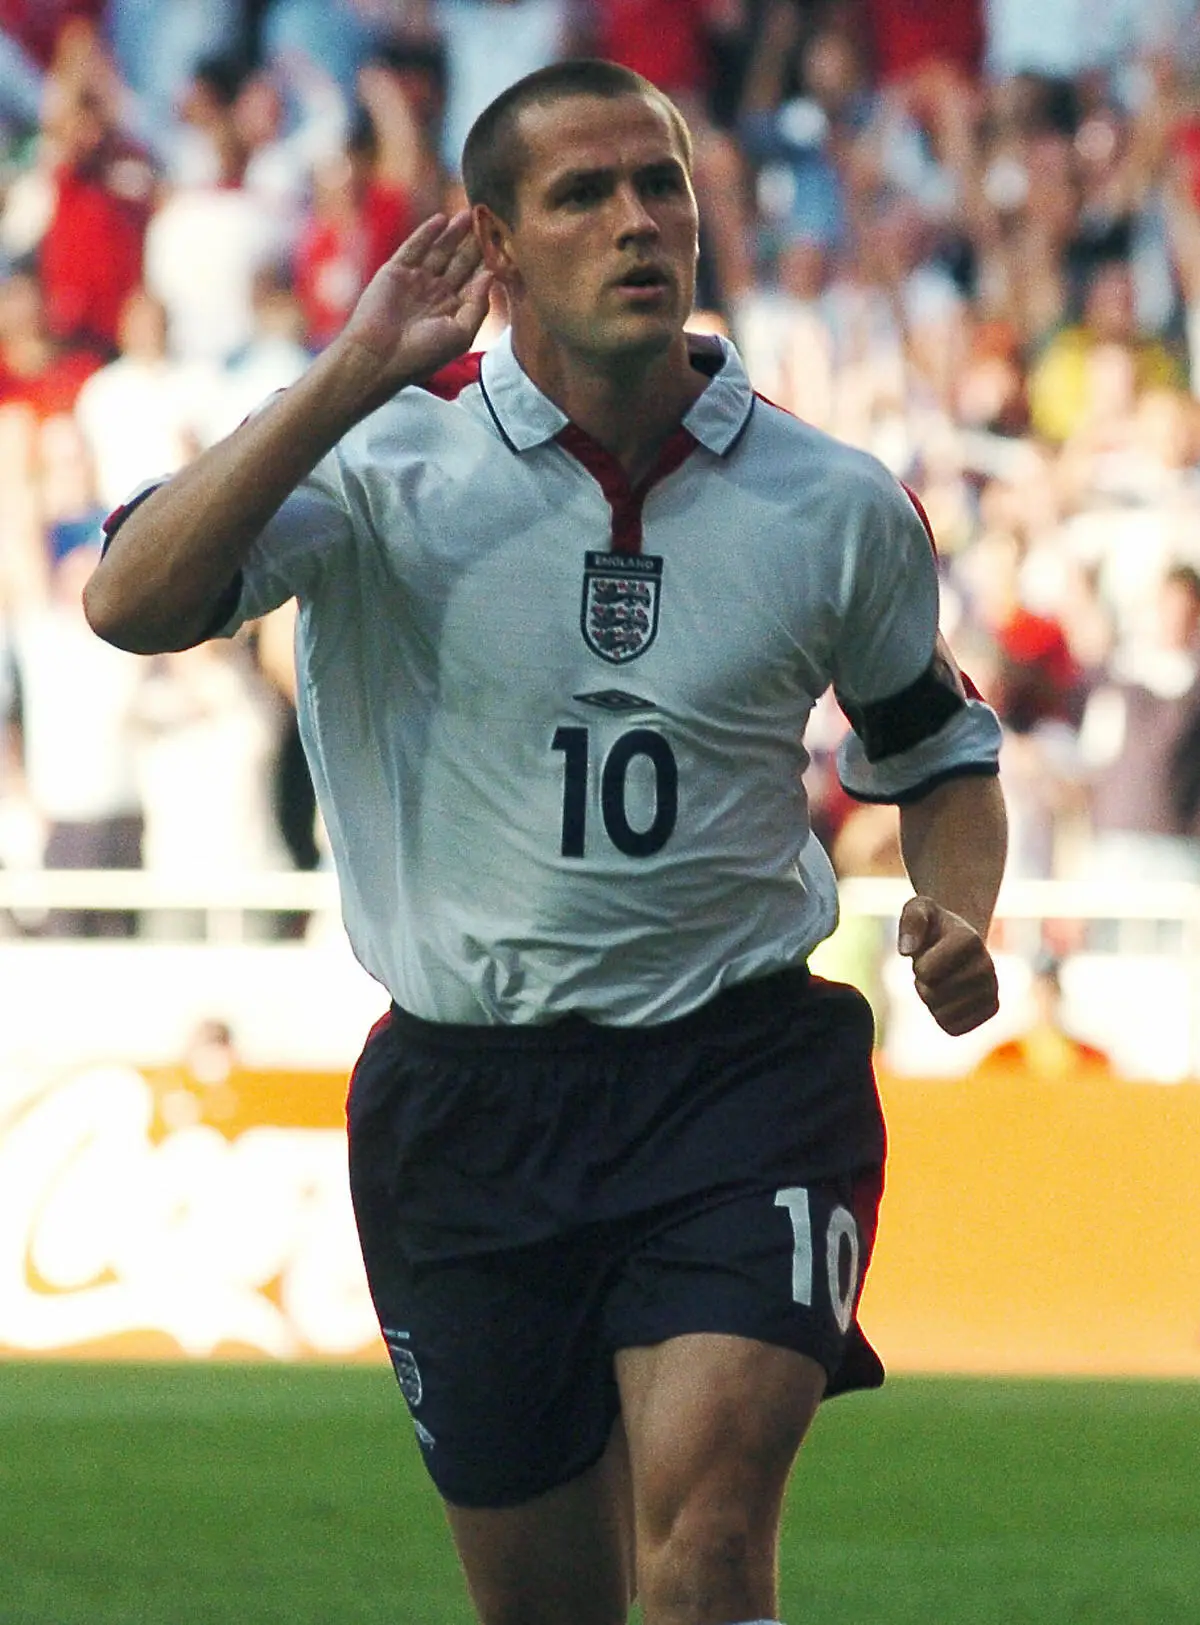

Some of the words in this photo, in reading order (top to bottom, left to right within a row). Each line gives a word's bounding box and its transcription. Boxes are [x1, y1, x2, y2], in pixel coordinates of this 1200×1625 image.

[595, 554, 654, 570] ENGLAND
[551, 726, 679, 858] 10
[774, 1187, 860, 1335] 10
